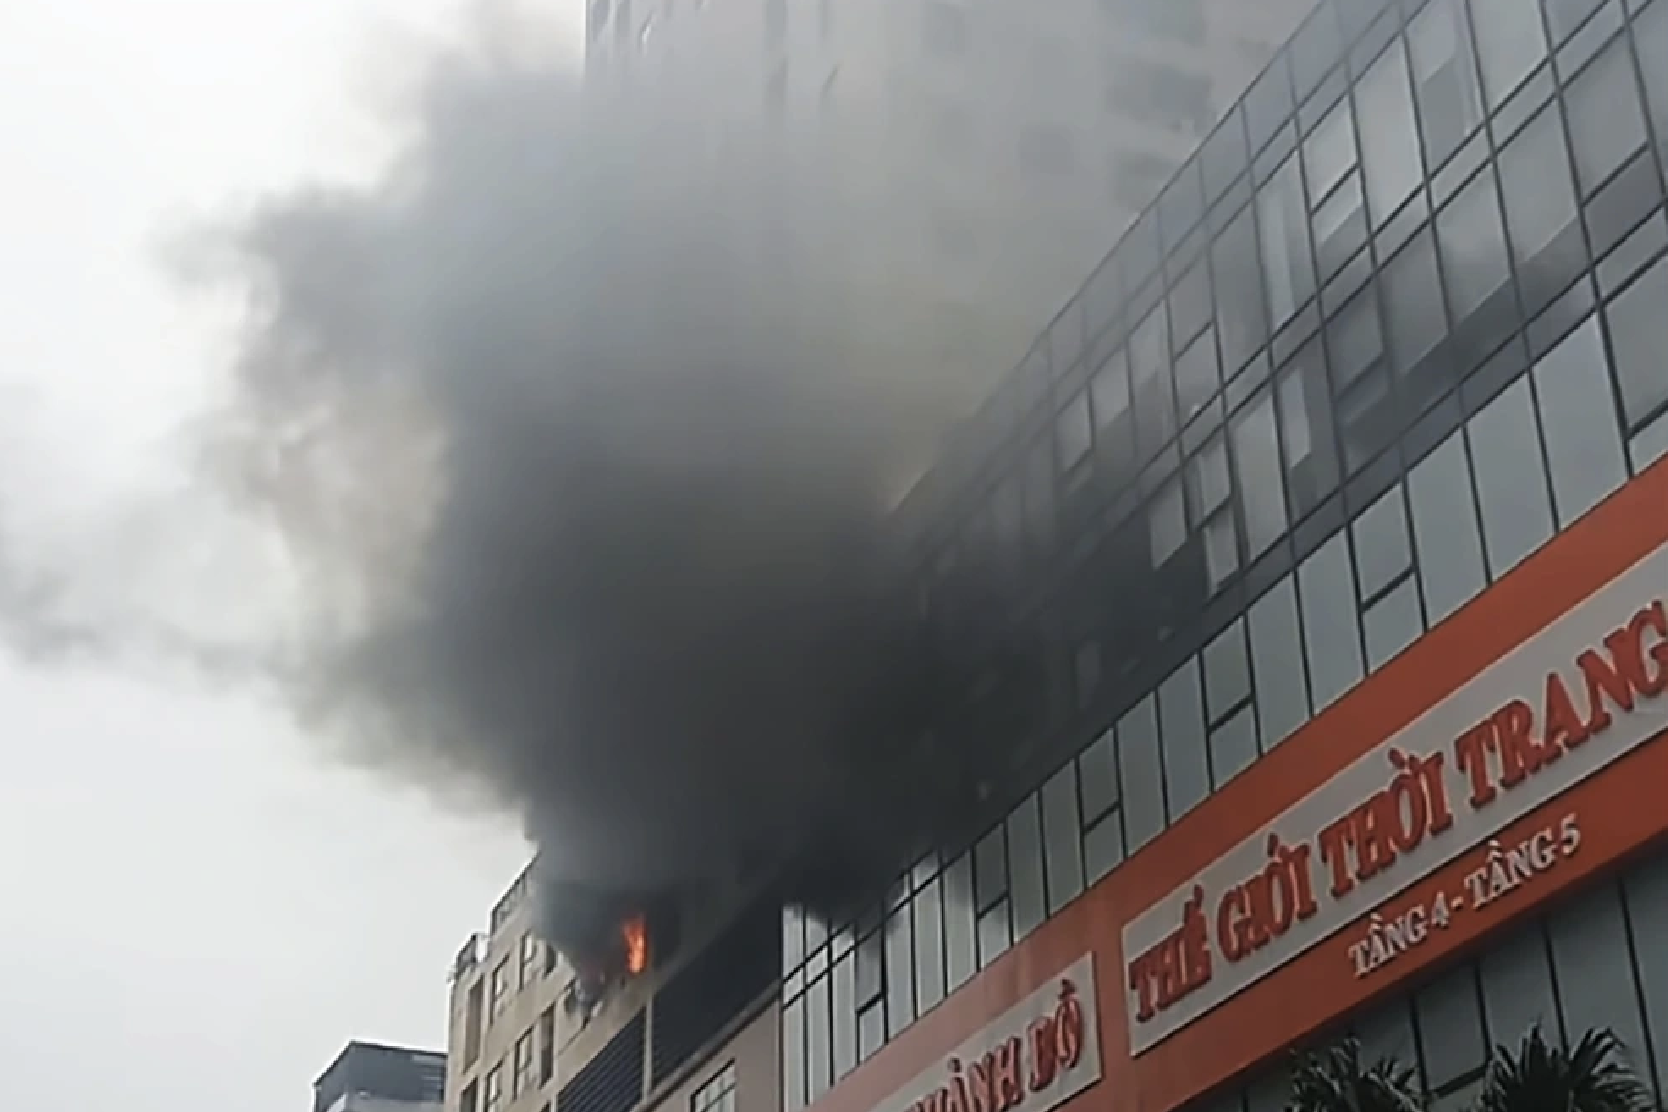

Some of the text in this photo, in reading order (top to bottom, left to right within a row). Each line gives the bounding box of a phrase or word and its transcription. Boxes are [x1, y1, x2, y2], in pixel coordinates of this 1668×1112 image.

[1128, 600, 1668, 1024] THẾ GIỚI THỜI TRANG
[1347, 904, 1428, 979] TẦNG
[1431, 890, 1449, 929] 4
[1464, 826, 1558, 910] TẦNG
[1559, 813, 1582, 857] 5
